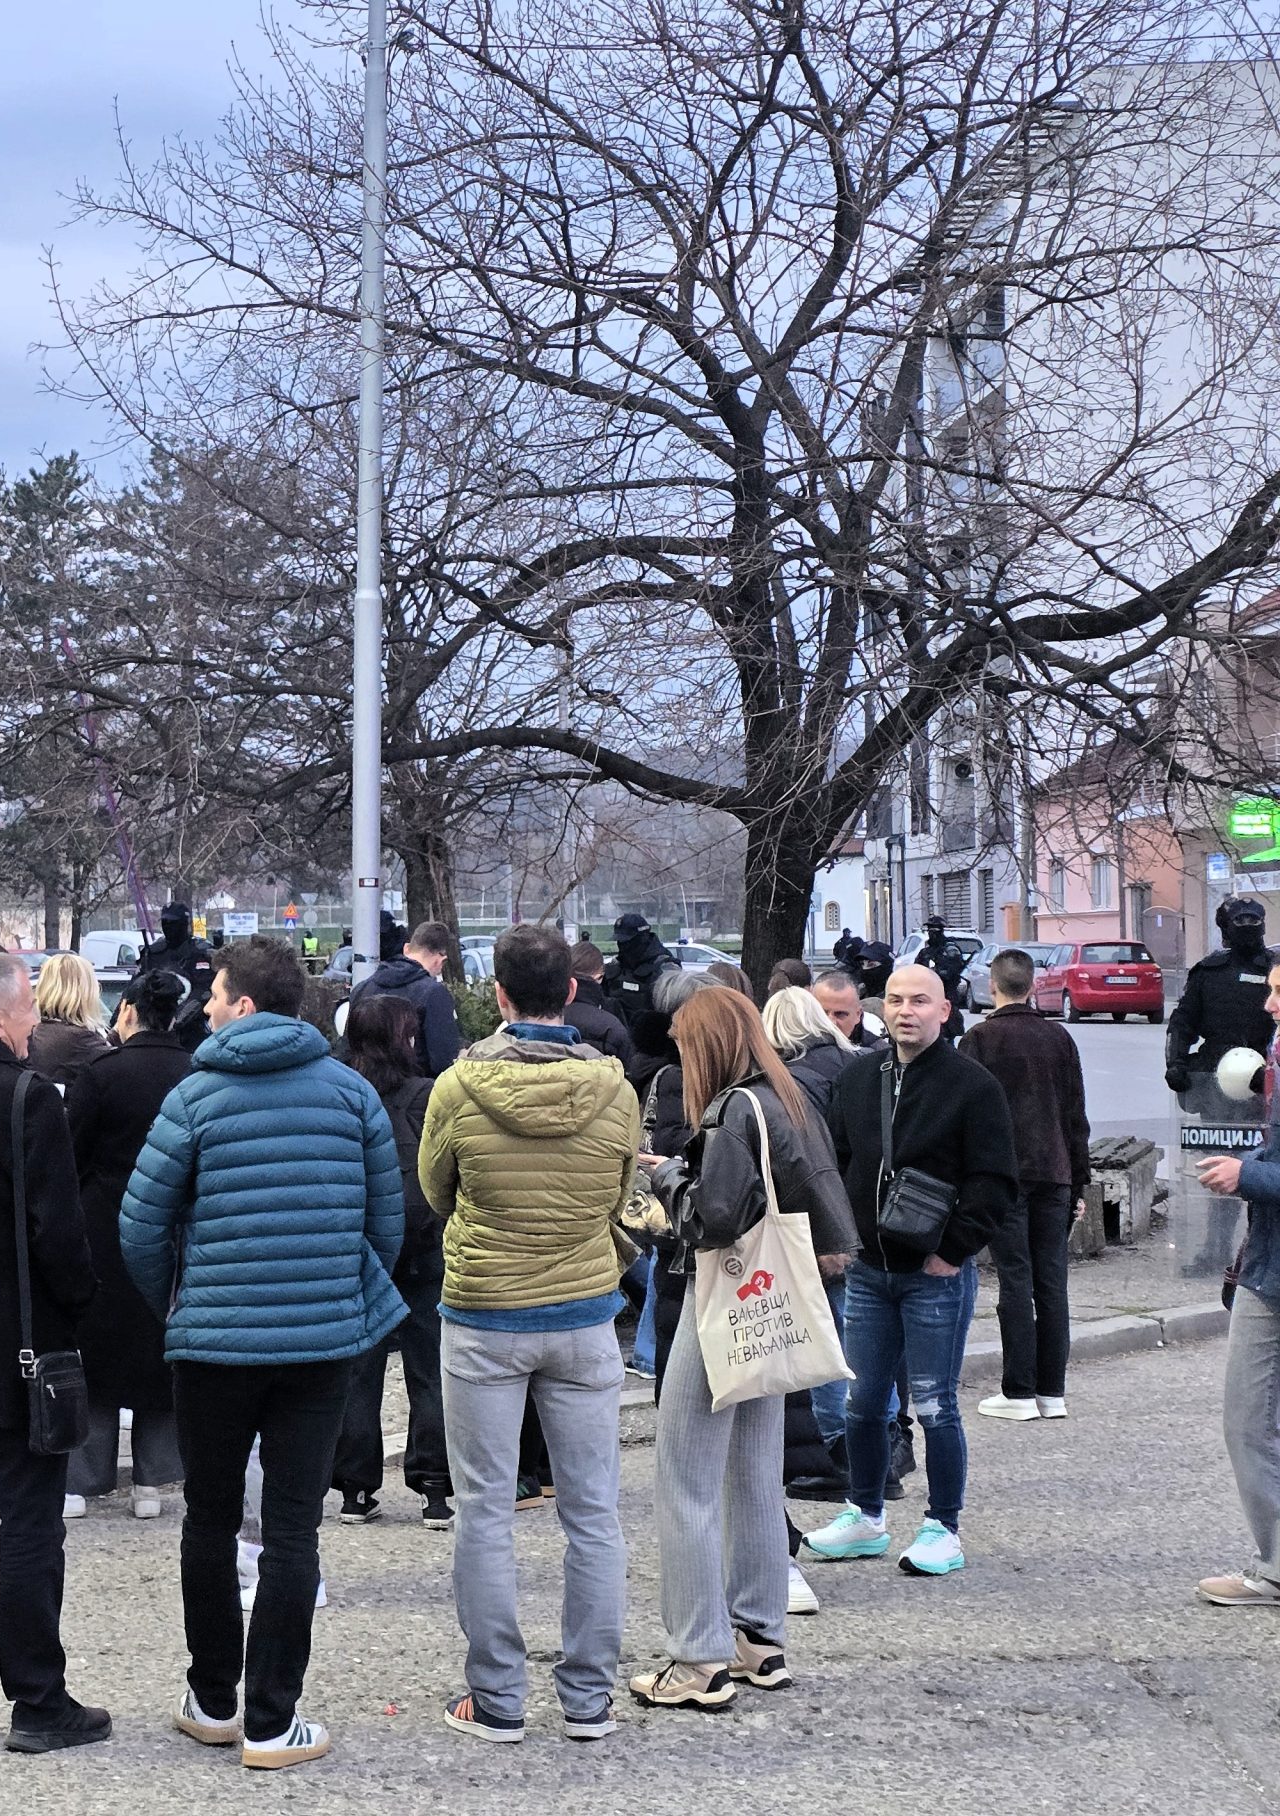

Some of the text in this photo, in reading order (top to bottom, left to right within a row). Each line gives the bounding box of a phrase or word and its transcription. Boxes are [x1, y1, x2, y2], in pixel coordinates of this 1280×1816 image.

[1181, 1128, 1264, 1149] ПОЛИЦИЈА
[728, 1291, 791, 1326] ВАЉЕВЦИ
[733, 1312, 794, 1343] ПРОТИВ
[727, 1328, 813, 1367] НЕВАЉАЛАЦА
